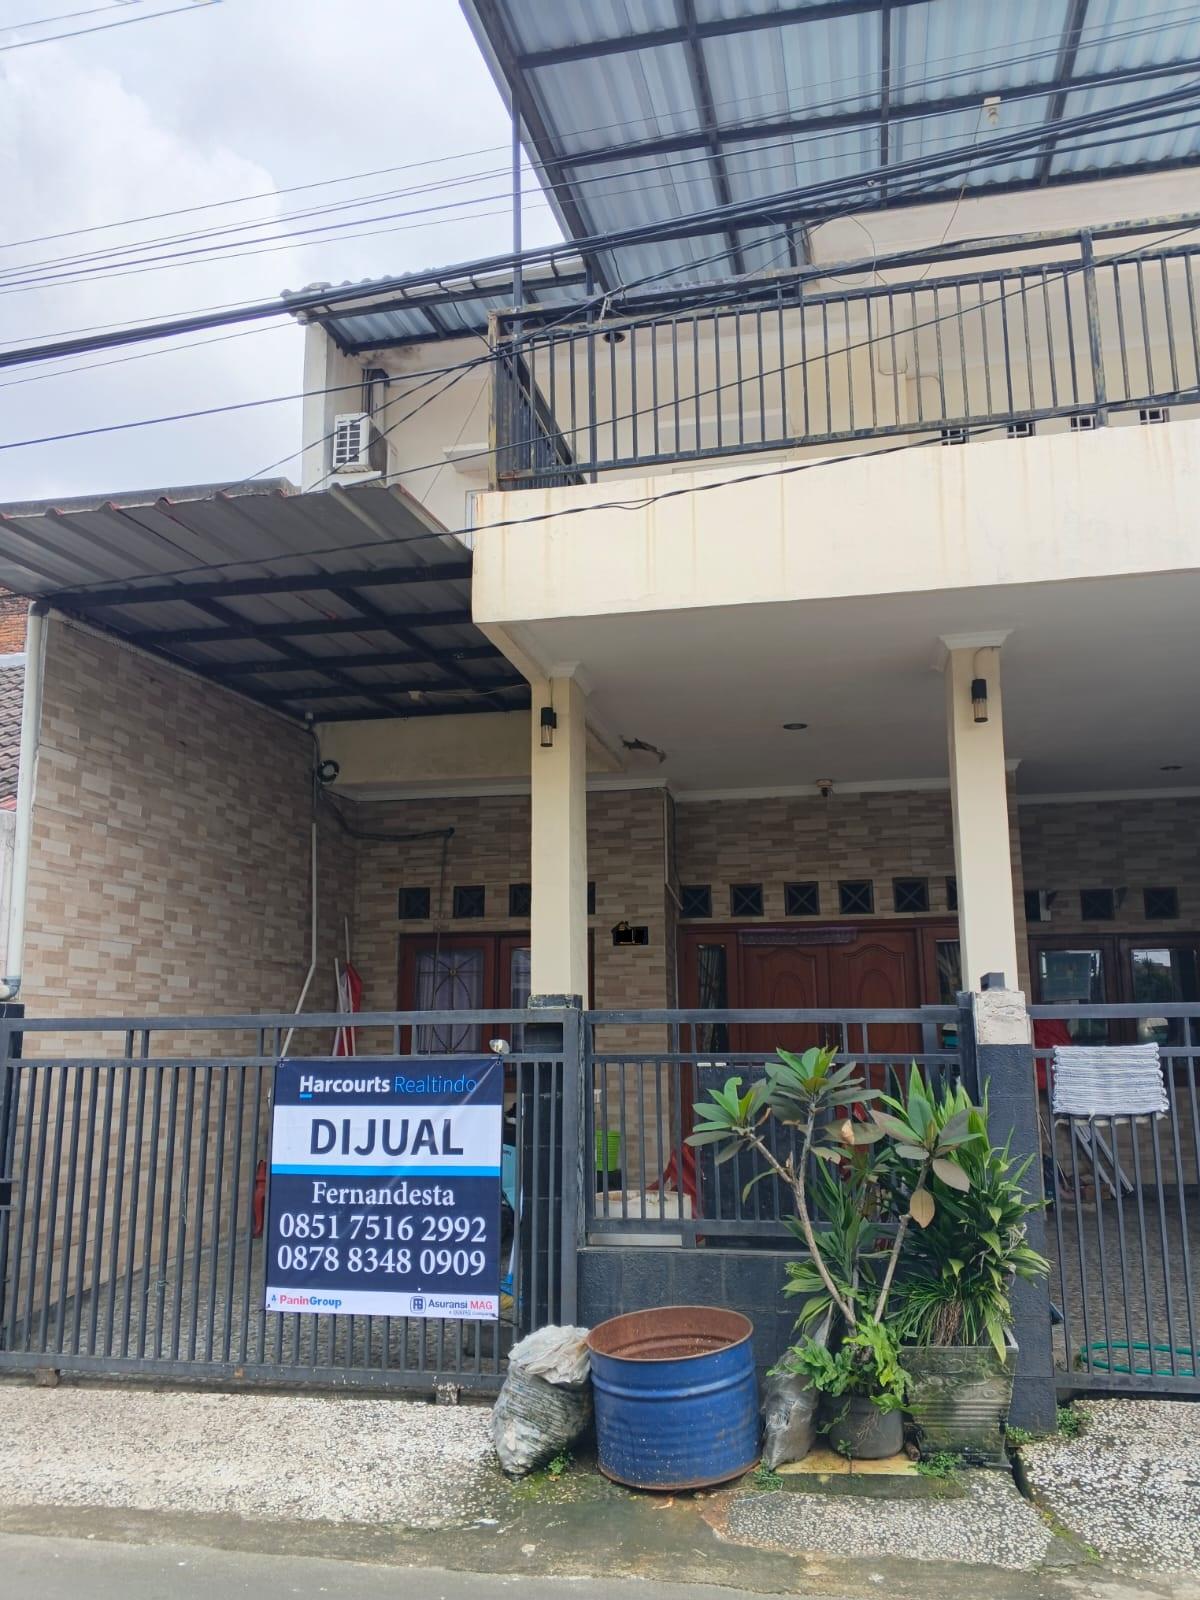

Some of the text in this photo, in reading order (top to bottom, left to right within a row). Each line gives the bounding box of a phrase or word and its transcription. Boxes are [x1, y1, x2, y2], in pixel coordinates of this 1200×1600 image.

[300, 1074, 477, 1093] Harcourts Realtindo
[310, 1118, 464, 1156] DIJUAL
[311, 1181, 455, 1206] Fernandesta
[279, 1213, 487, 1243] 0851 7516 2992
[277, 1245, 486, 1276] 0878 8348 0909
[279, 1294, 342, 1308] PaninGroup
[428, 1300, 468, 1309] Asuransi
[470, 1301, 493, 1310] MAG
